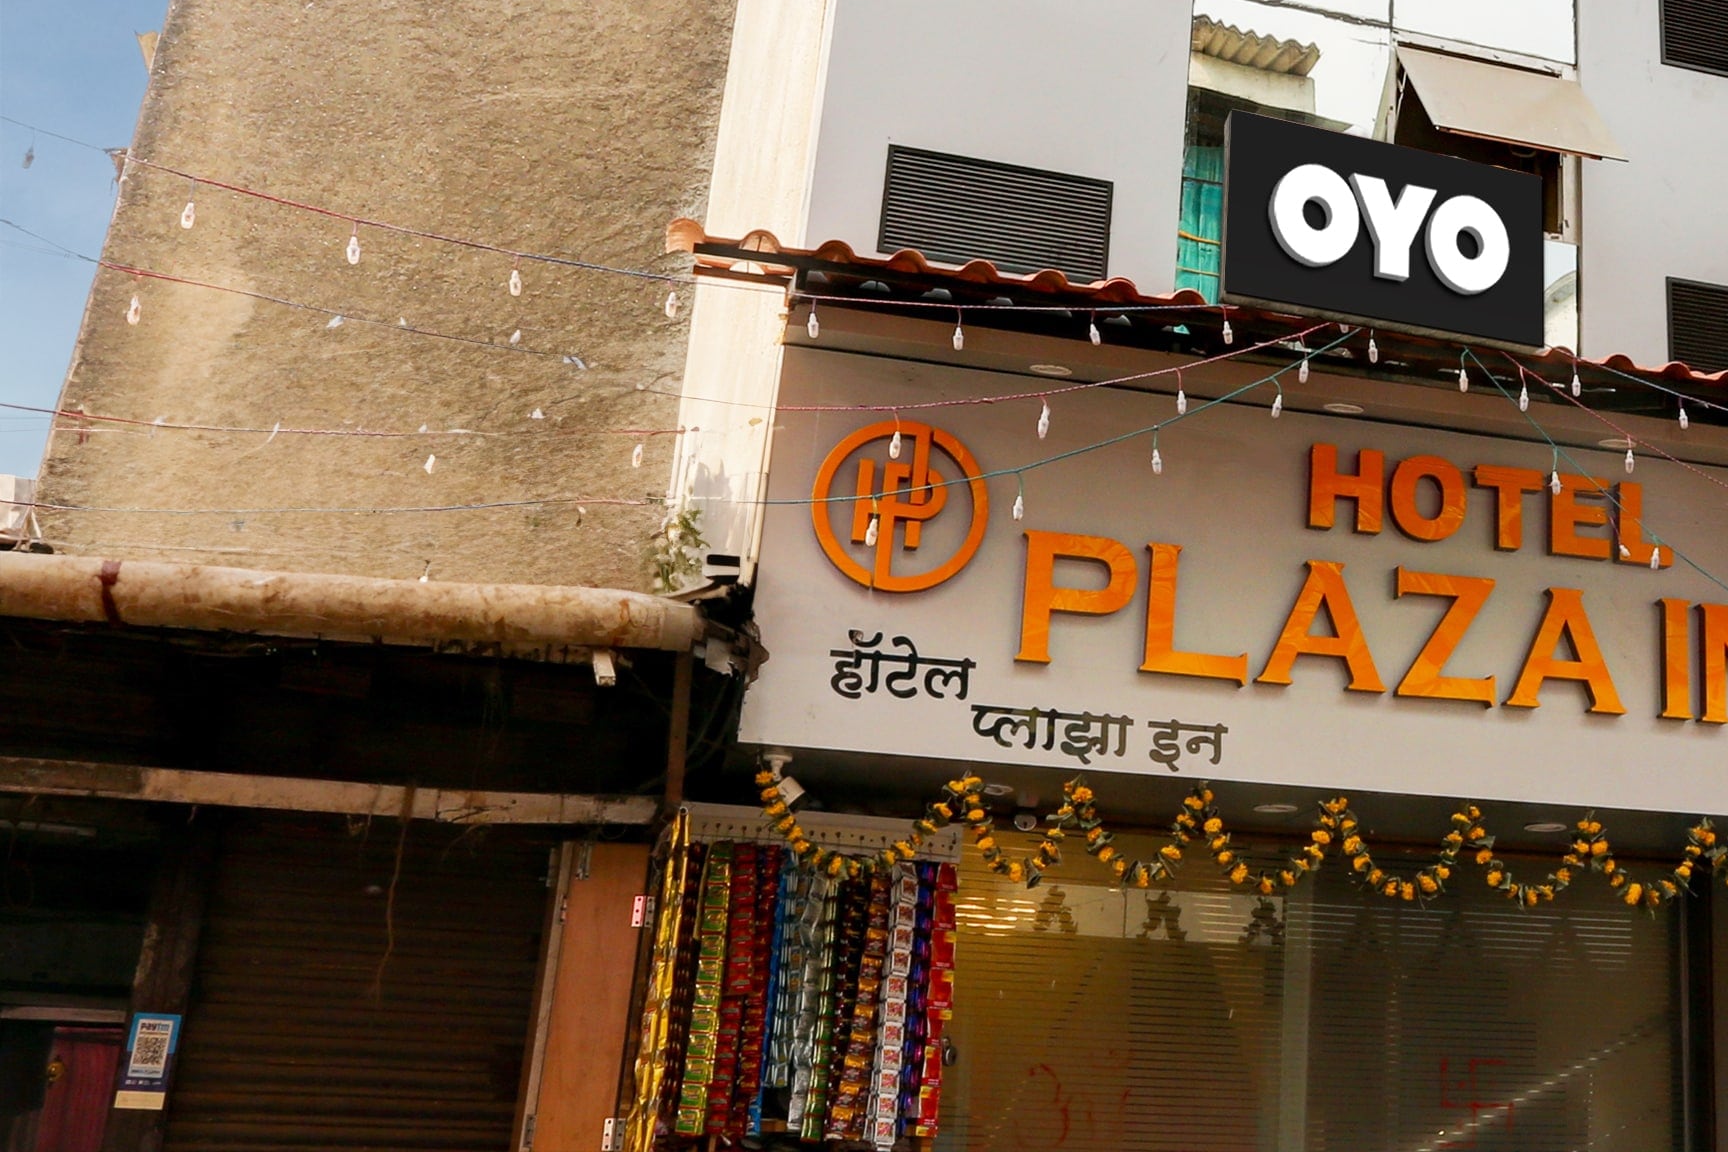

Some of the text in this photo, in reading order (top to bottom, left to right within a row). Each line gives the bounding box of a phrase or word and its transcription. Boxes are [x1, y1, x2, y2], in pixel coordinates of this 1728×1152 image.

[1268, 163, 1511, 295] OYO
[1308, 442, 1674, 568] HOTEL
[830, 629, 976, 700] हॉटेल
[1013, 529, 1627, 717] PLAZA
[971, 703, 1228, 772] प्लाझा इन
